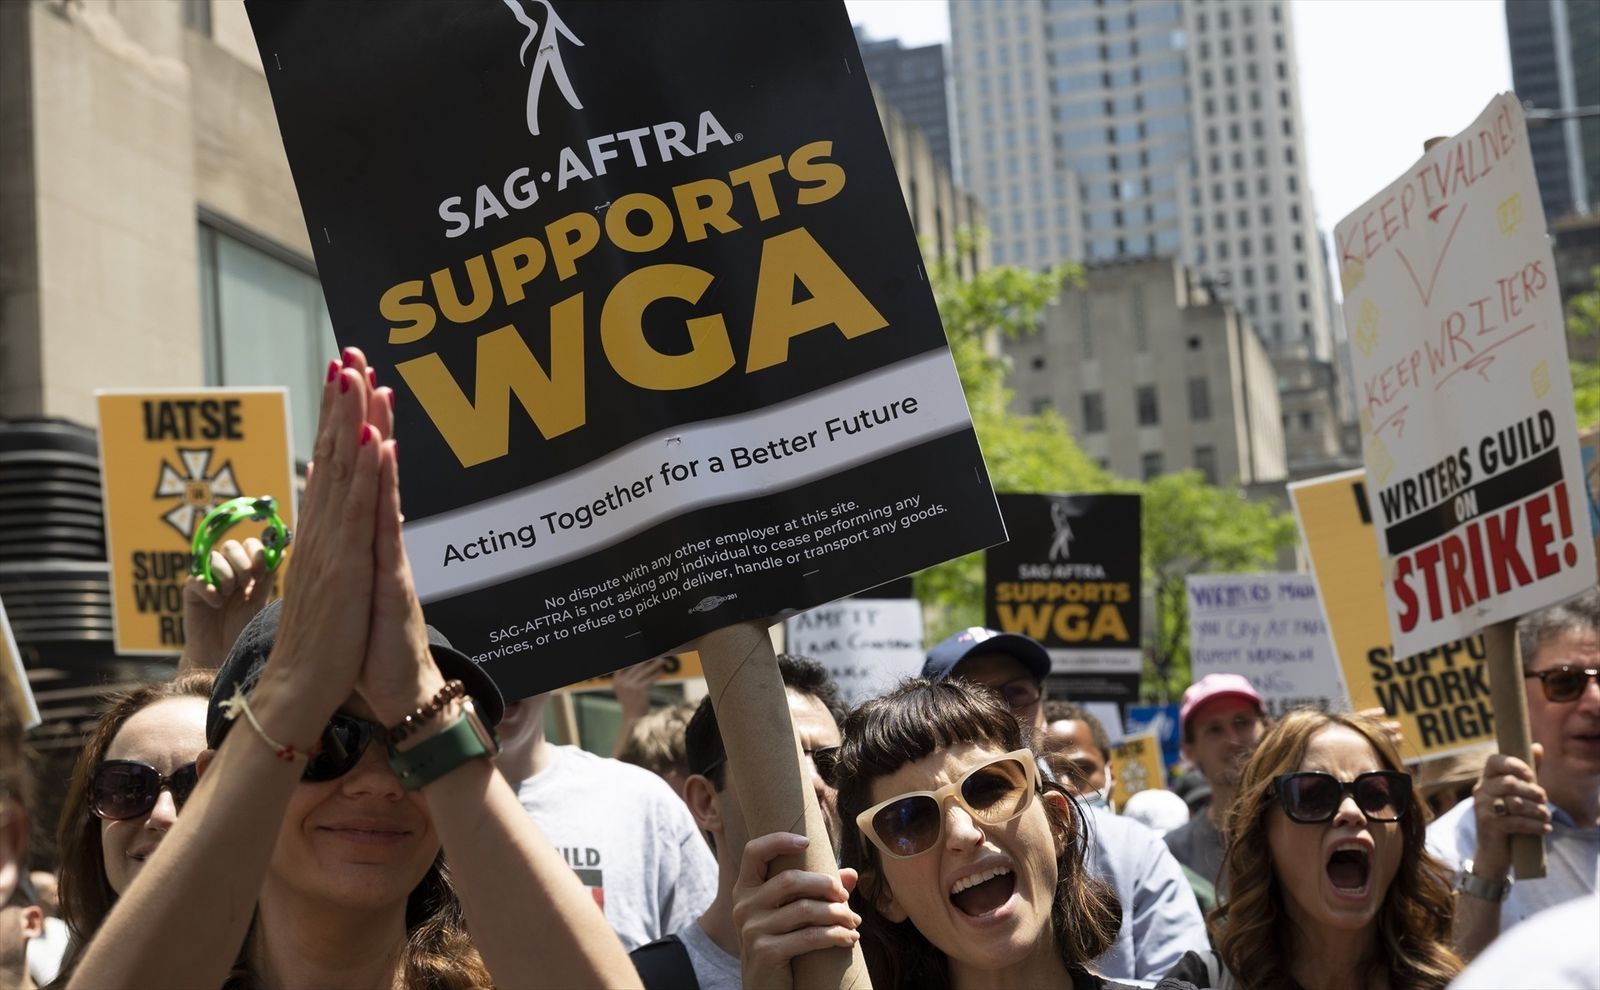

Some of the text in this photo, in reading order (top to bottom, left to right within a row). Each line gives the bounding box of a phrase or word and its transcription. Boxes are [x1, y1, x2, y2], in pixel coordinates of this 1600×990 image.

[1339, 183, 1417, 264] KEEP
[1452, 104, 1516, 195] ALIVE!
[378, 140, 847, 345] SUPPORTS
[393, 226, 891, 469] WGA
[1364, 260, 1549, 417] KEEP WRITERS
[142, 399, 243, 441] IATSE
[1379, 446, 1473, 524] WRITERS
[1479, 409, 1556, 475] GUILD
[442, 396, 918, 567] Acting Together for a Better Future
[1455, 490, 1479, 523] ON
[133, 552, 193, 580] SUP
[133, 584, 184, 613] WO
[471, 504, 948, 665] services, or to refuse to pick up, deliver, handle or transport any goods.
[489, 494, 920, 643] SAG-AFTRA is not asking any individual to cease performing any
[544, 501, 860, 610] No dispute with any other employer at this site.
[996, 582, 1130, 602] SUPPORTS
[1393, 482, 1577, 633] STRIKE!
[160, 616, 185, 645] RI
[995, 604, 1130, 641] WGA
[1374, 664, 1491, 718] WORK
[1417, 702, 1494, 748] RIGH
